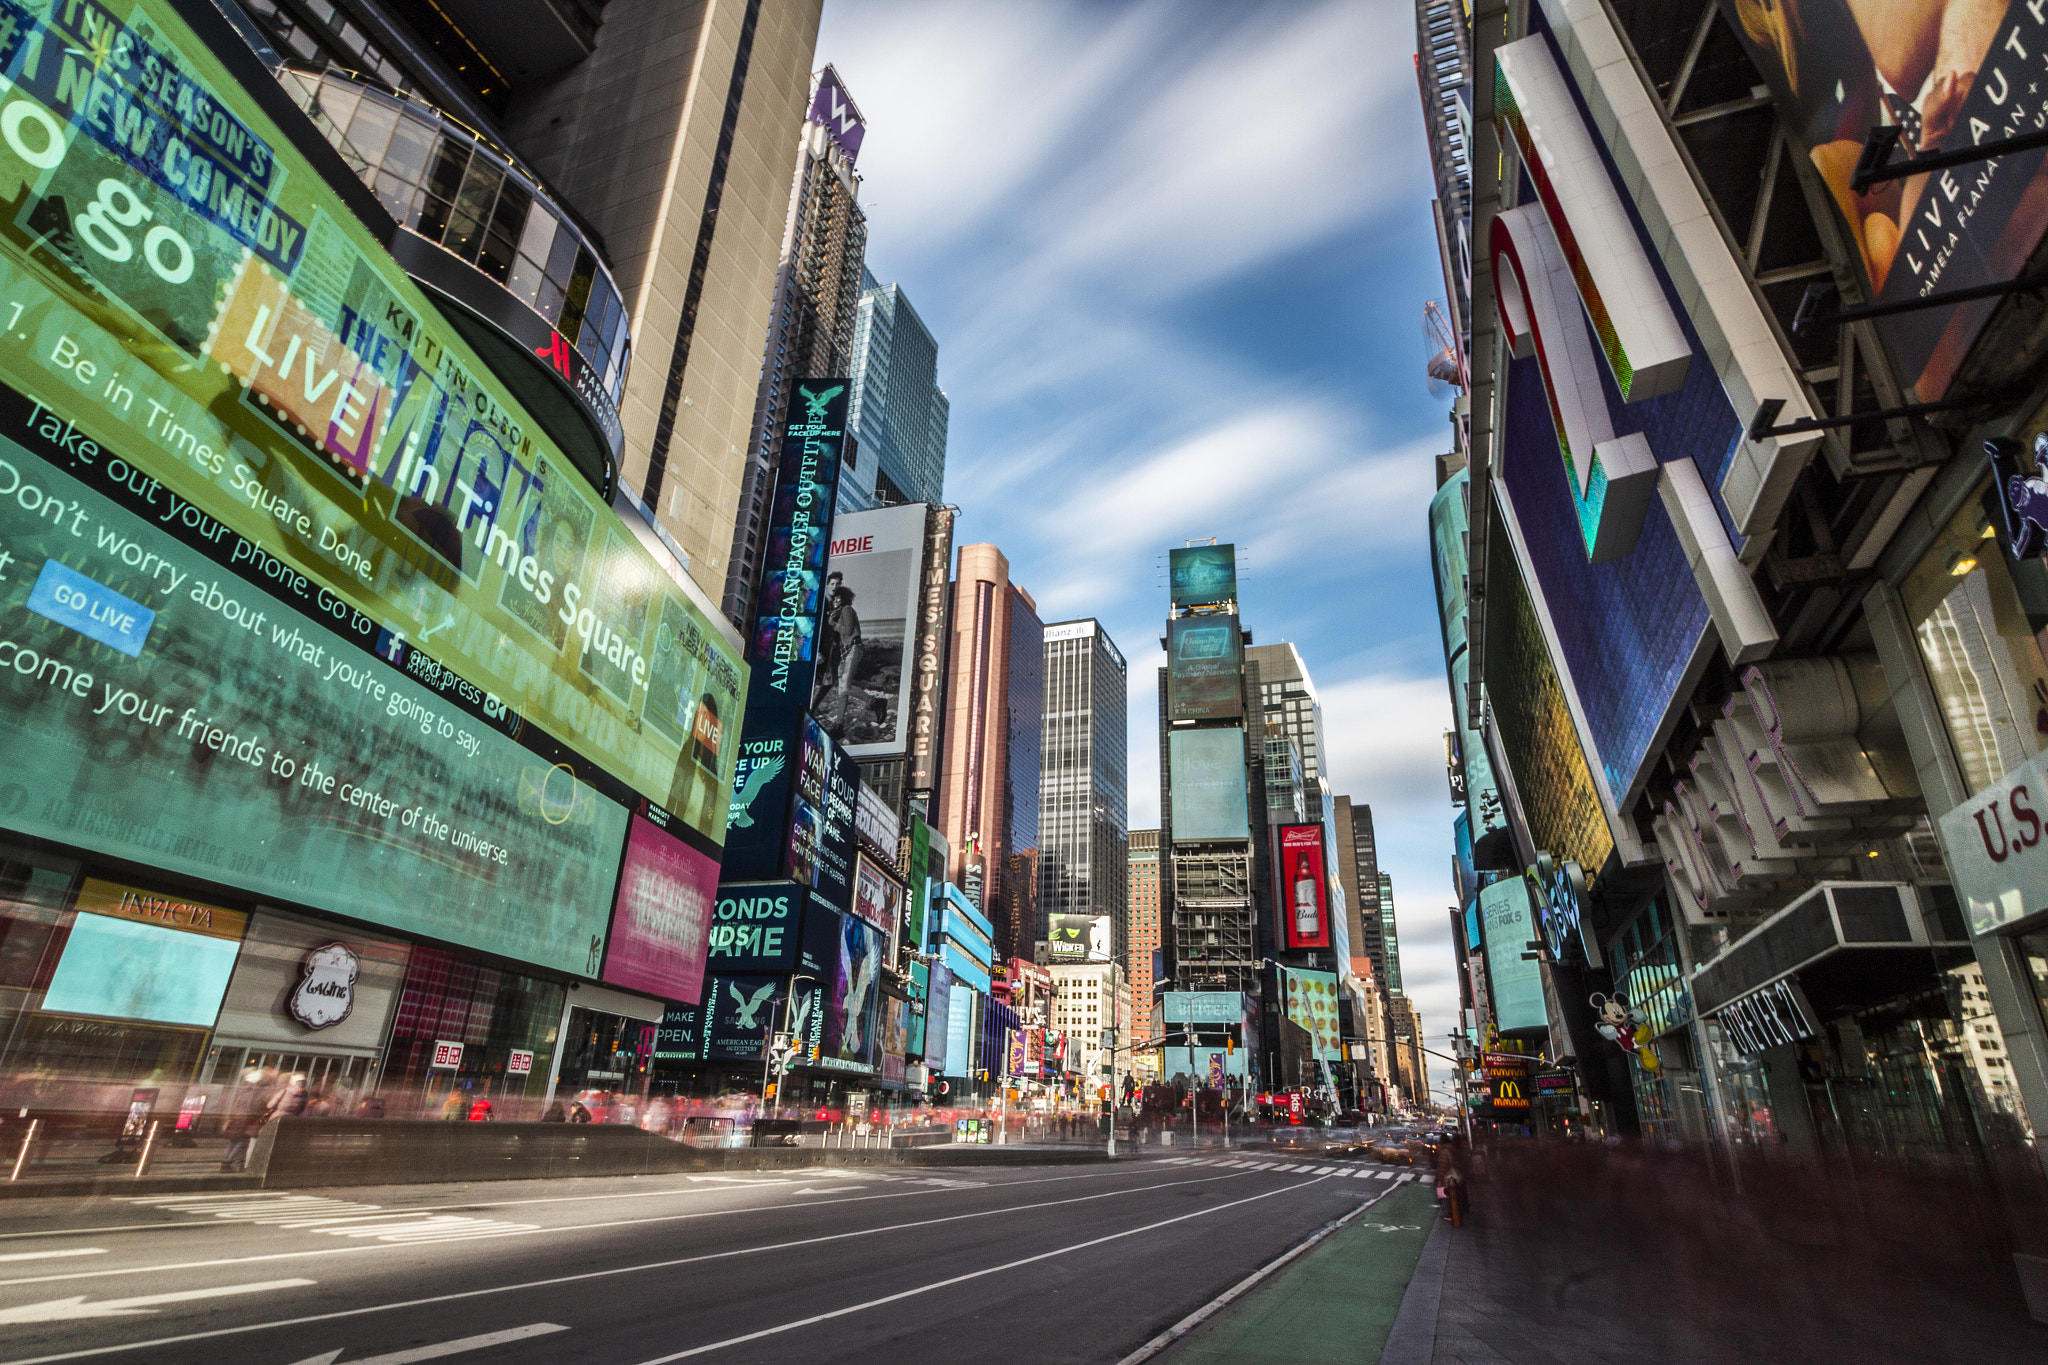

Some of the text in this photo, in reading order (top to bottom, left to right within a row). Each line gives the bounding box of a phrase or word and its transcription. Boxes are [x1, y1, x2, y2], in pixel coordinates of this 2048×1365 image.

[142, 53, 269, 178] SEASON'S
[831, 84, 856, 135] W
[163, 138, 299, 265] COMEDY
[75, 178, 195, 284] go
[1906, 170, 1960, 275] LIVE
[577, 378, 613, 437] MARQUIS
[580, 364, 619, 429] MARRIOTT
[50, 335, 97, 385] Be
[103, 372, 134, 411] in
[147, 398, 226, 474] Times
[229, 464, 313, 540] Square.
[320, 529, 374, 582] Done.
[244, 304, 367, 437] LIVE
[397, 431, 440, 506] in
[455, 478, 552, 604] Times
[558, 582, 649, 690] Square.
[26, 393, 99, 464] Take
[107, 458, 162, 504] out
[160, 492, 231, 545] your
[232, 536, 310, 600] phone.
[317, 587, 347, 619] Go
[351, 606, 372, 636] to
[443, 669, 481, 705] press
[0, 460, 481, 757] Don't worry about what you're going to say.
[54, 585, 136, 634] GO LIVE
[770, 578, 801, 692] AMERICAN
[1172, 670, 1205, 678] Payment
[1196, 663, 1220, 671] Global
[913, 634, 939, 756] SQUARE
[697, 713, 719, 746] LIVE
[744, 740, 784, 755] YOUR
[93, 683, 173, 728] your
[177, 707, 266, 767] friends
[272, 750, 296, 779] to
[301, 762, 335, 795] the
[339, 781, 398, 820] center
[401, 805, 423, 829] of
[424, 812, 449, 840] the
[451, 831, 509, 866] universe.
[751, 757, 770, 769] UP
[804, 742, 832, 783] WANT
[801, 769, 820, 800] FACE
[648, 812, 667, 827] MARQUIS
[649, 803, 670, 820] MARRIOTT
[792, 839, 804, 856] HOW
[805, 848, 812, 862] TO
[119, 891, 213, 929] INVICTA
[905, 888, 913, 927] NEW
[1485, 899, 1511, 919] SERIES
[1499, 911, 1514, 927] FOX
[1515, 910, 1522, 922] 5
[1052, 940, 1085, 953] WICKED
[666, 1012, 695, 1022] MAKE
[812, 988, 822, 1018] EAGLE
[1717, 979, 1814, 1056] FOREVER 21
[1291, 1093, 1300, 1112] tkts
